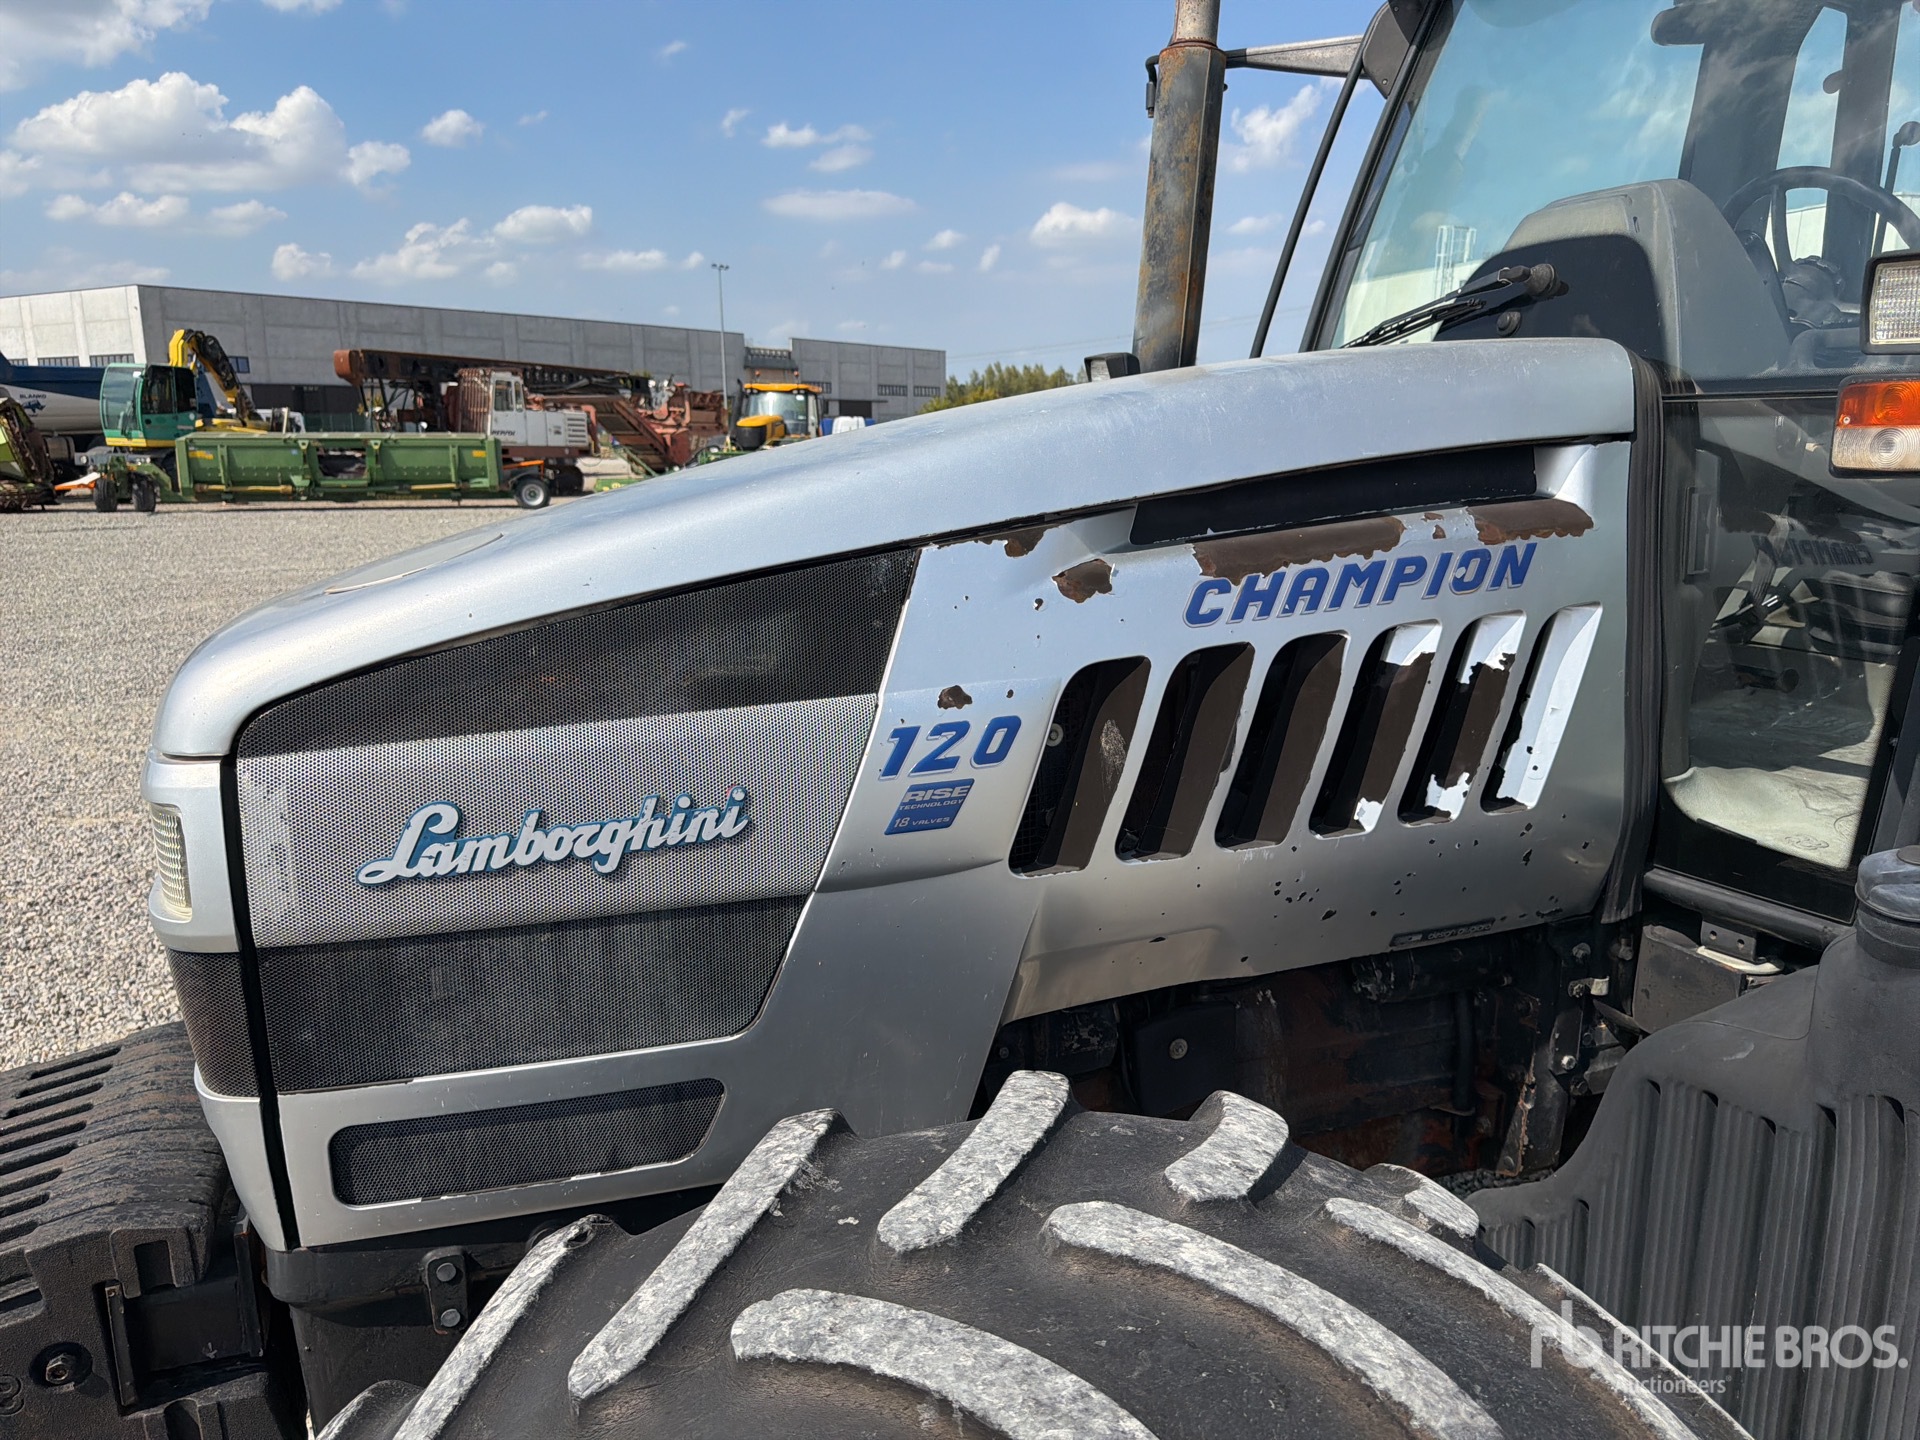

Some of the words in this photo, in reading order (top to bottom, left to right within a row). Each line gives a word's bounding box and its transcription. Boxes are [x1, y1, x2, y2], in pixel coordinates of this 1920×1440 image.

[1183, 543, 1537, 628] CHAMPION
[880, 715, 1022, 780] 120
[899, 798, 964, 811] TECHNOLOGY
[901, 784, 971, 804] RISE
[355, 785, 750, 886] Lamborghini
[893, 817, 910, 828] 18
[912, 816, 950, 826] VALVES
